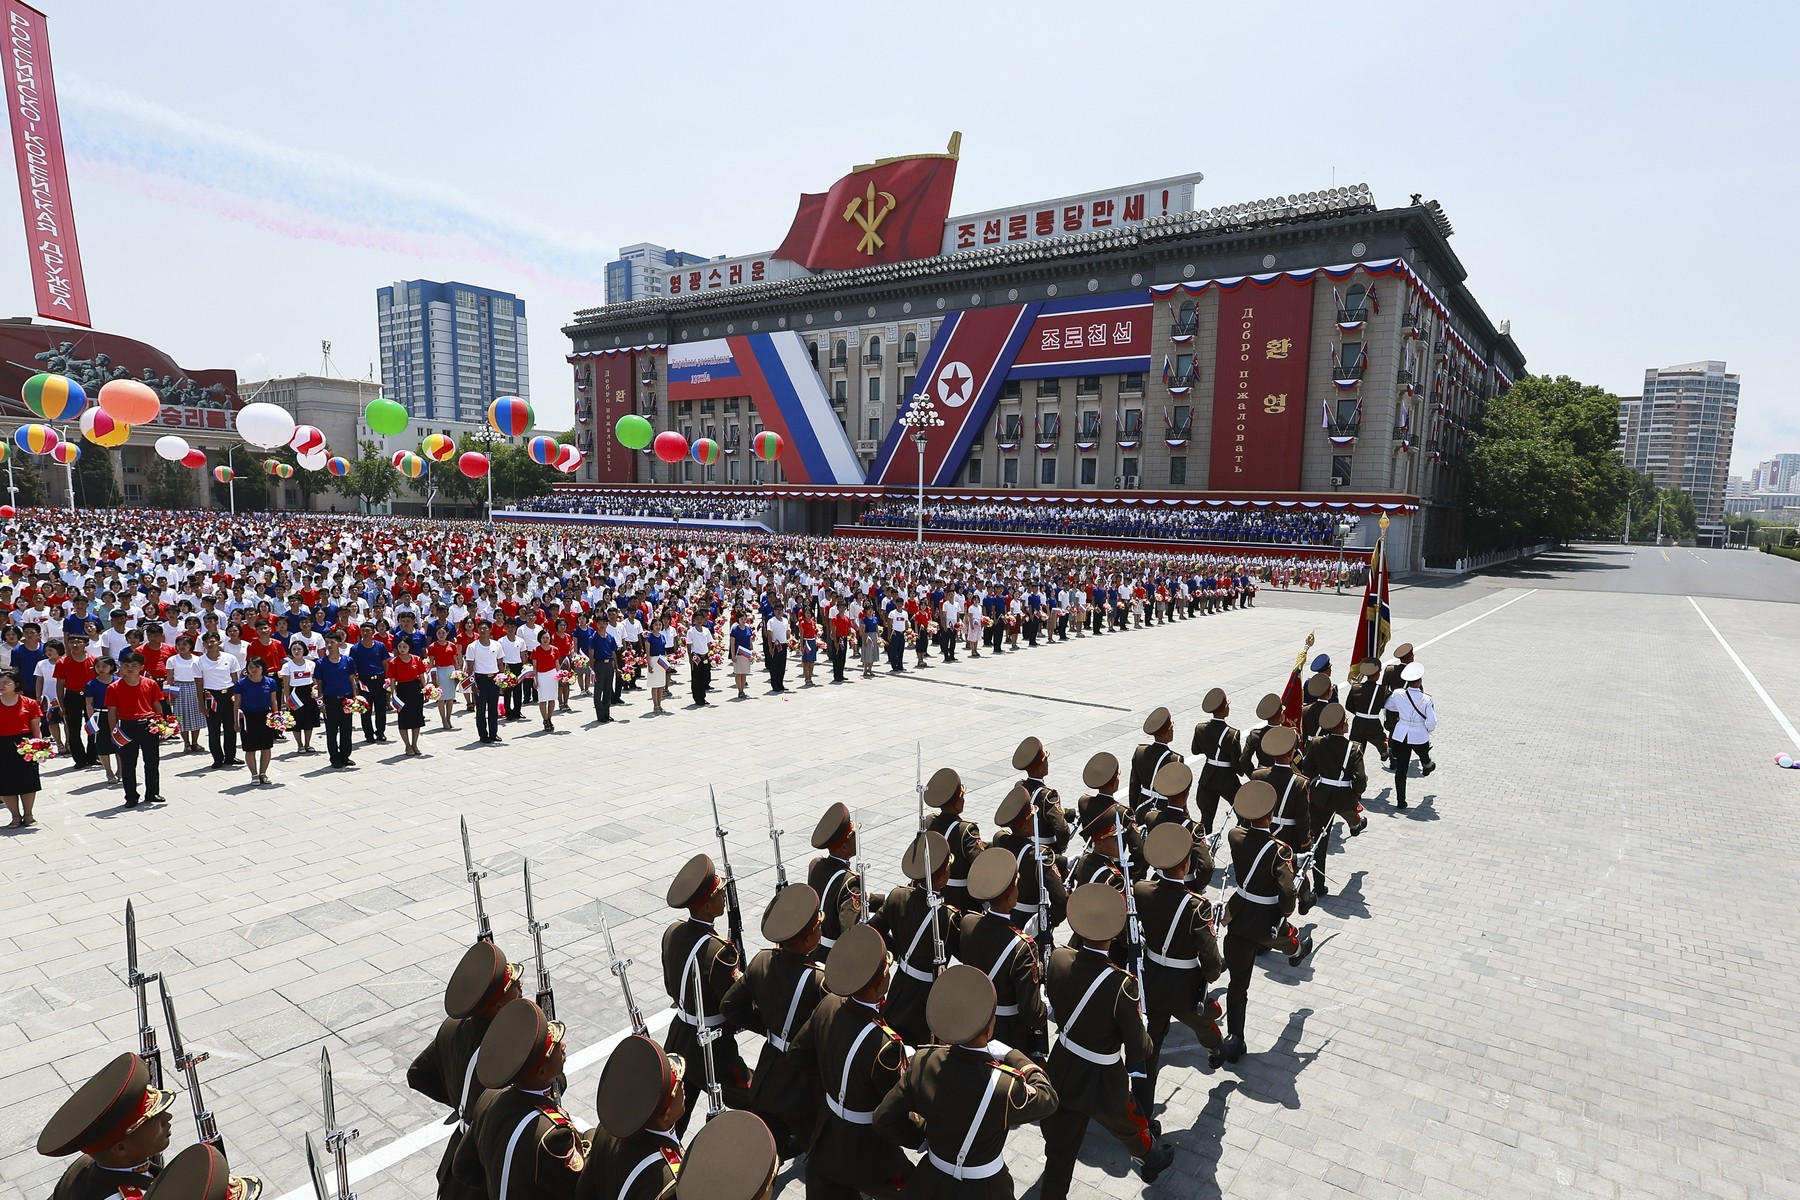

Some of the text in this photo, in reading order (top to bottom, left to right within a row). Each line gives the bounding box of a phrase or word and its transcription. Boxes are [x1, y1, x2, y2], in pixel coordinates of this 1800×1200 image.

[40, 240, 72, 311] ДРУЖБА
[669, 260, 765, 293] 영광스러운
[1041, 321, 1133, 351] 조로친선
[1234, 308, 1254, 473] Добро пожаловать
